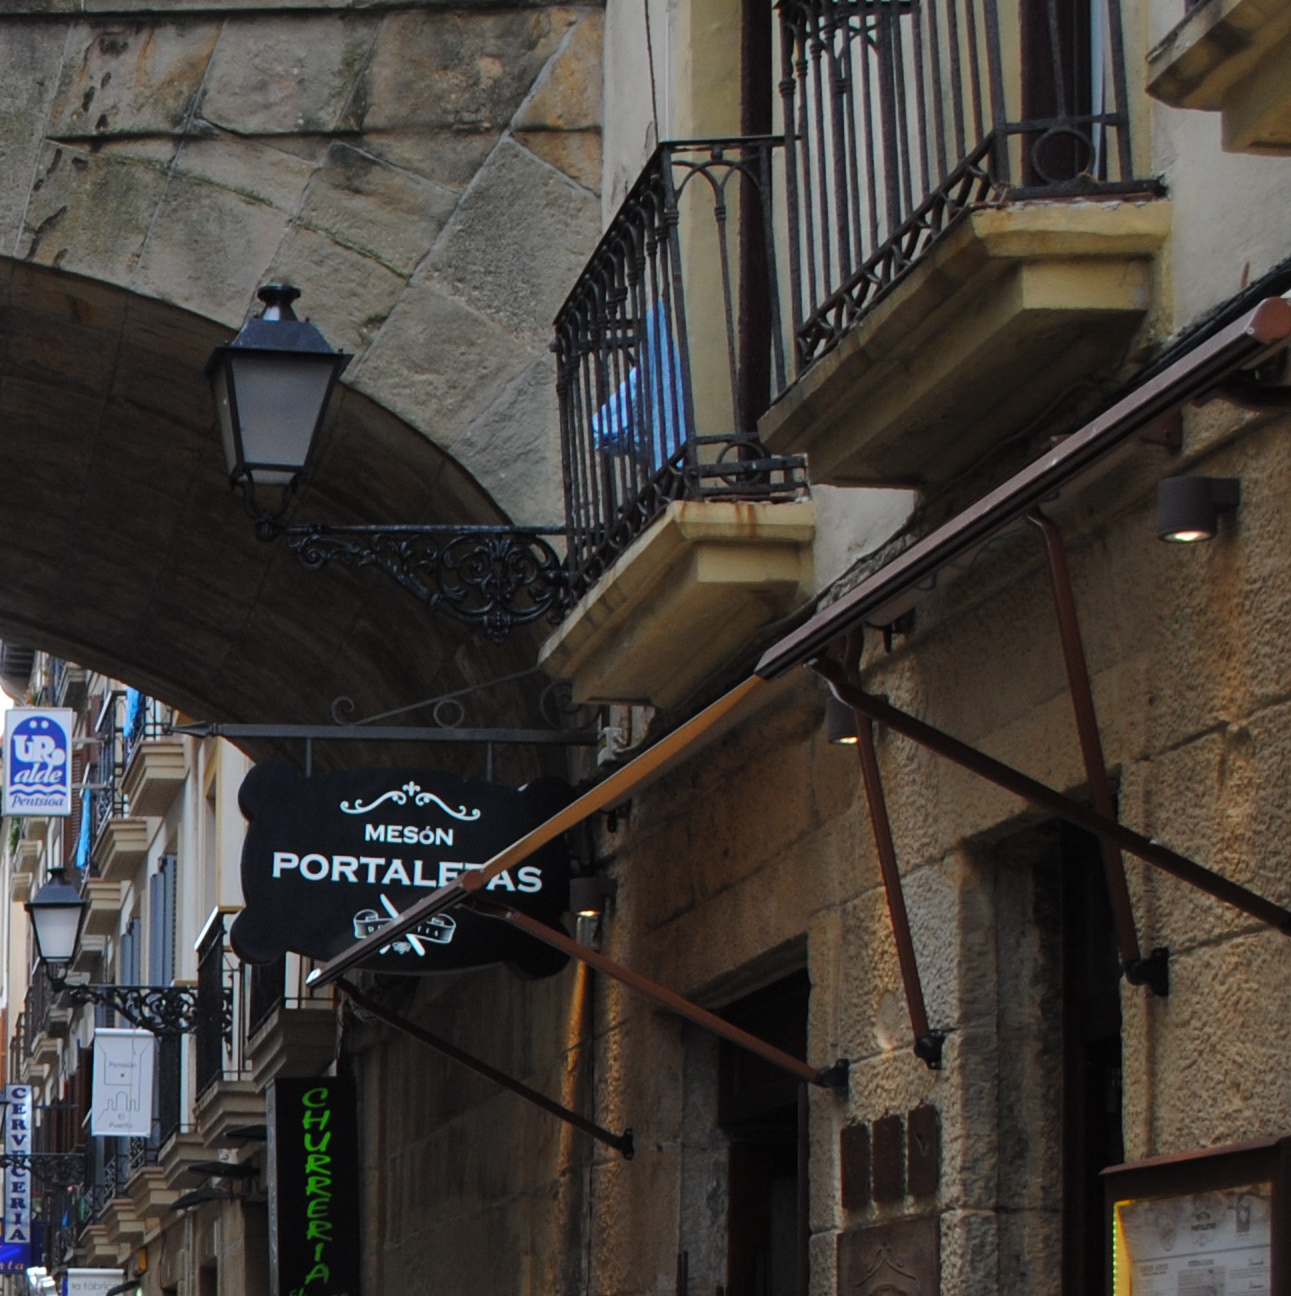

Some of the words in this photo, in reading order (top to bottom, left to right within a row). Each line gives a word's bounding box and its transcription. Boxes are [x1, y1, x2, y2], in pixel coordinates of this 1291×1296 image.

[13, 762, 63, 784] alde
[11, 1087, 27, 1241] CERVECERIA
[302, 1087, 333, 1284] CHURRERIA
